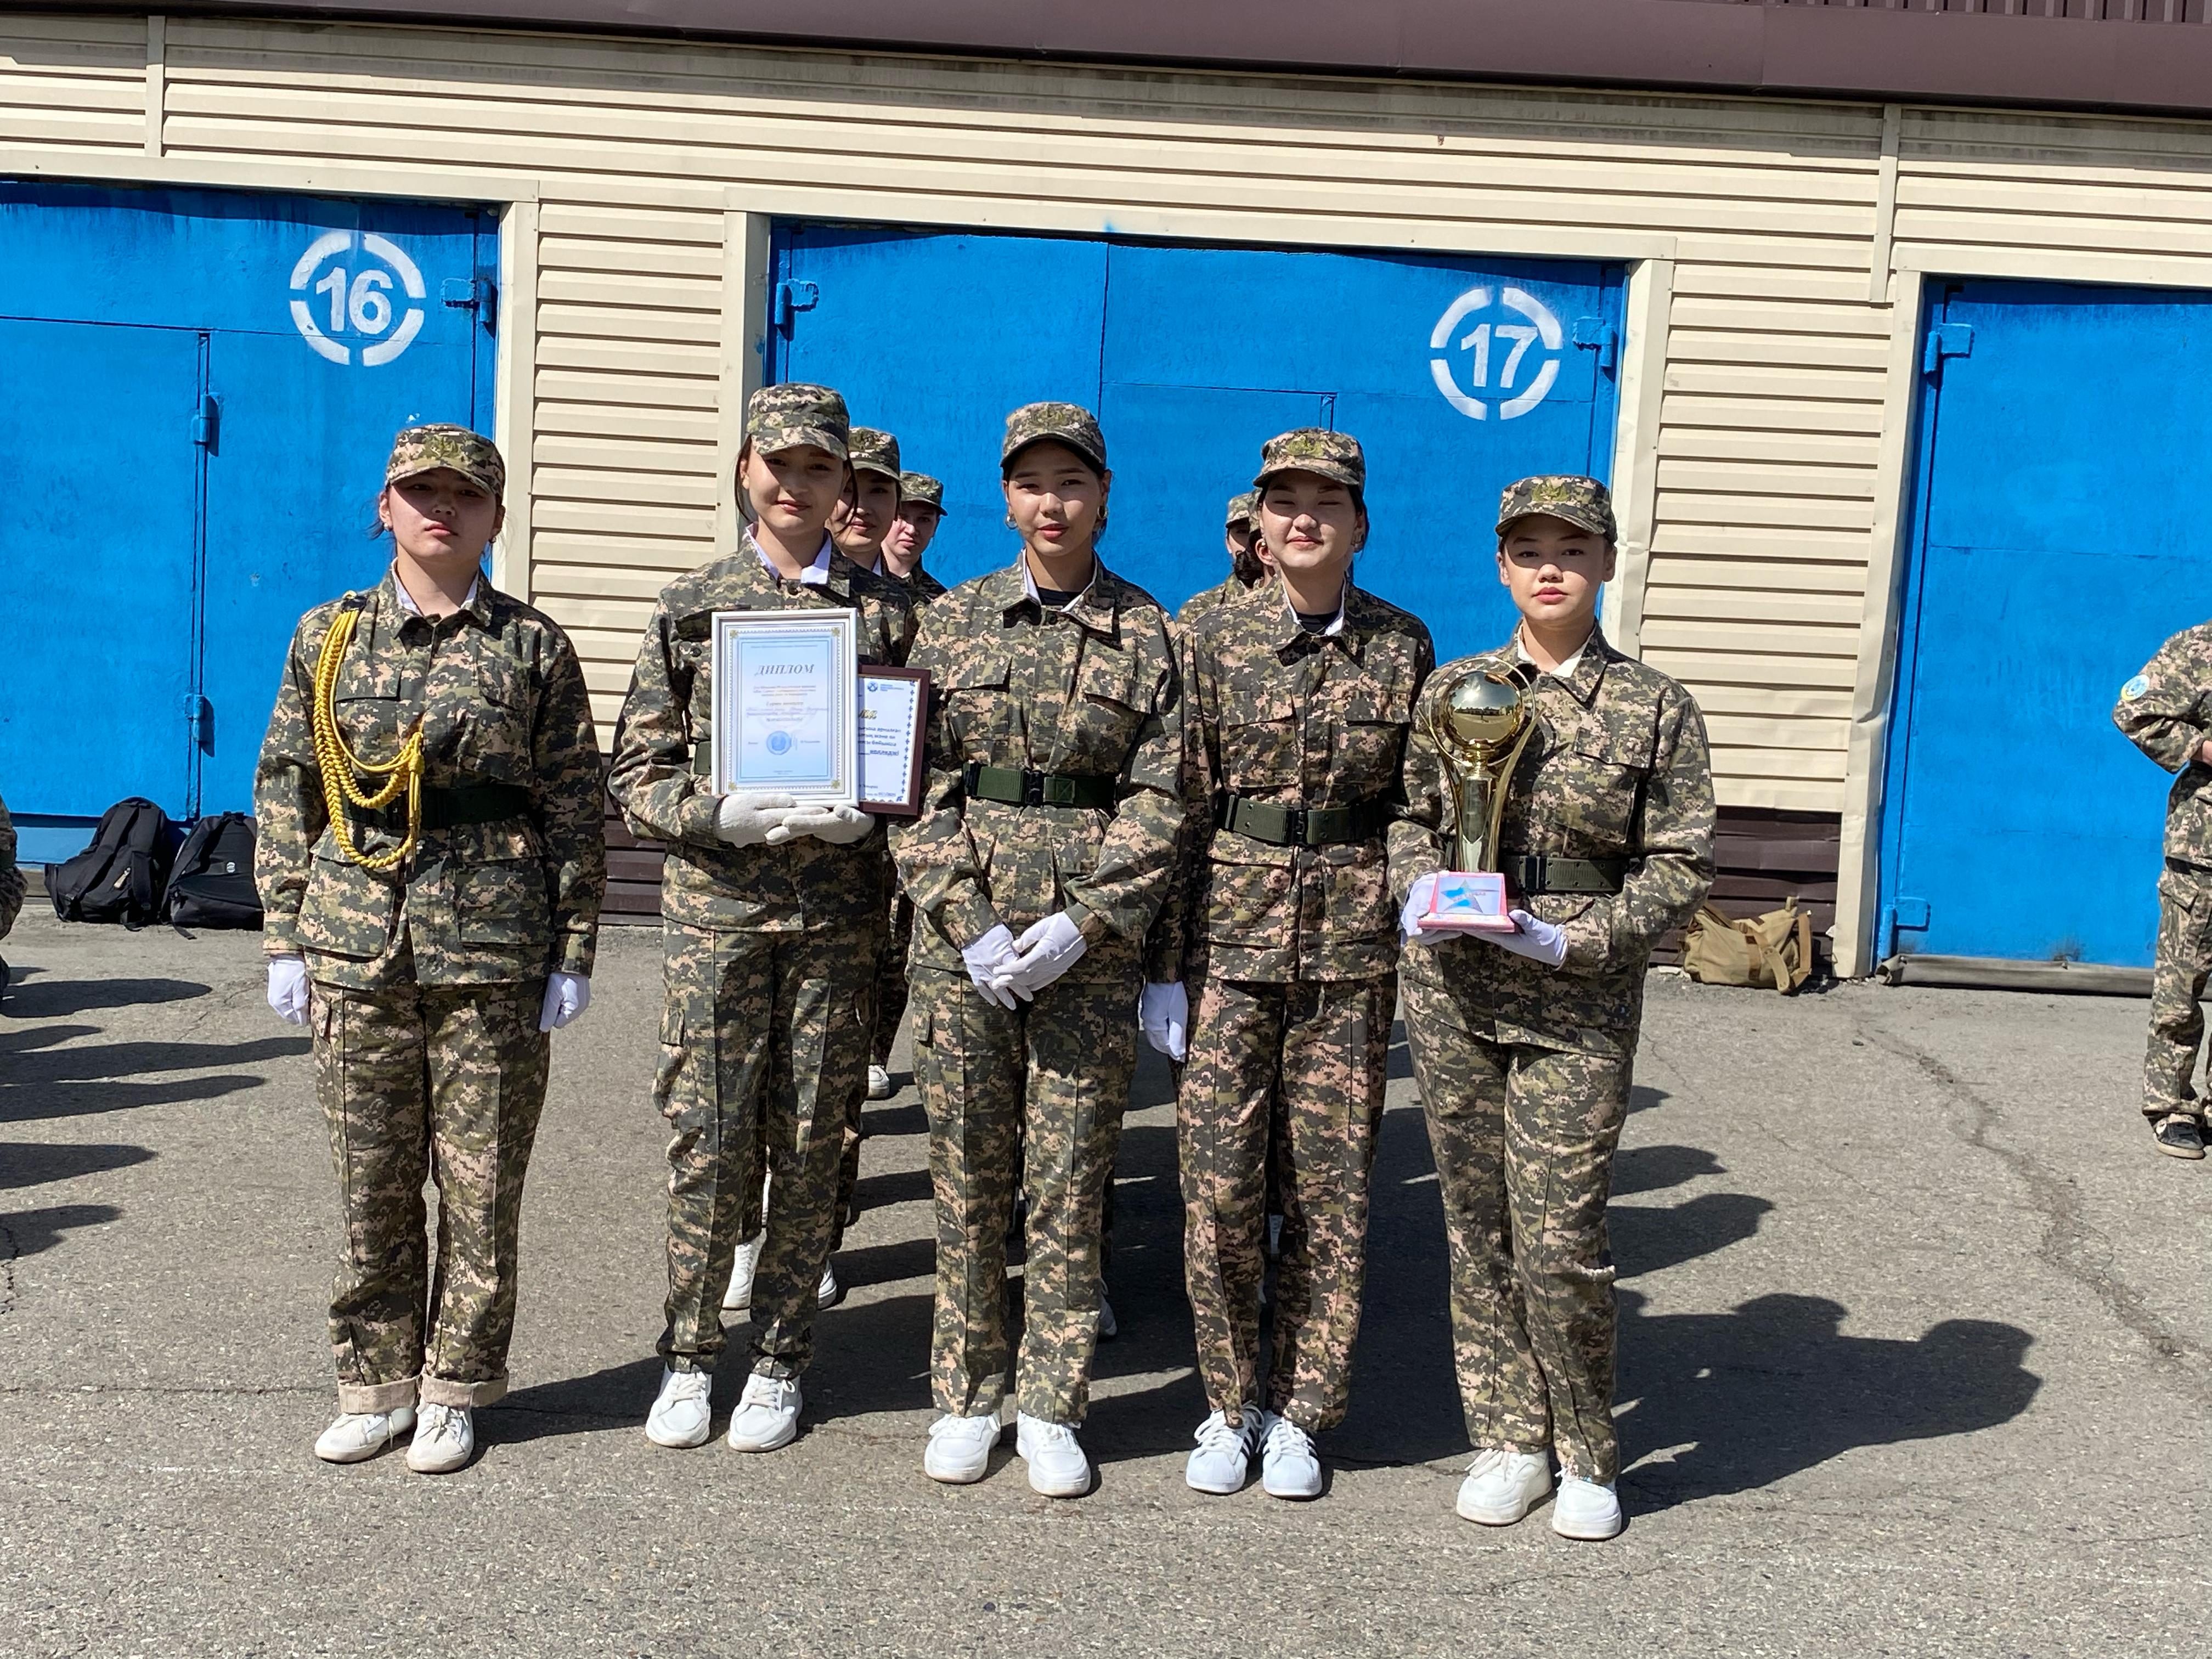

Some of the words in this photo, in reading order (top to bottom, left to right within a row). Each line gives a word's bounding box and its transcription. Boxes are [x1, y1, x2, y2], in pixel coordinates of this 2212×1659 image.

[316, 267, 393, 334] 16
[1461, 324, 1538, 388] 17
[754, 664, 815, 676] ДИПЛОМ
